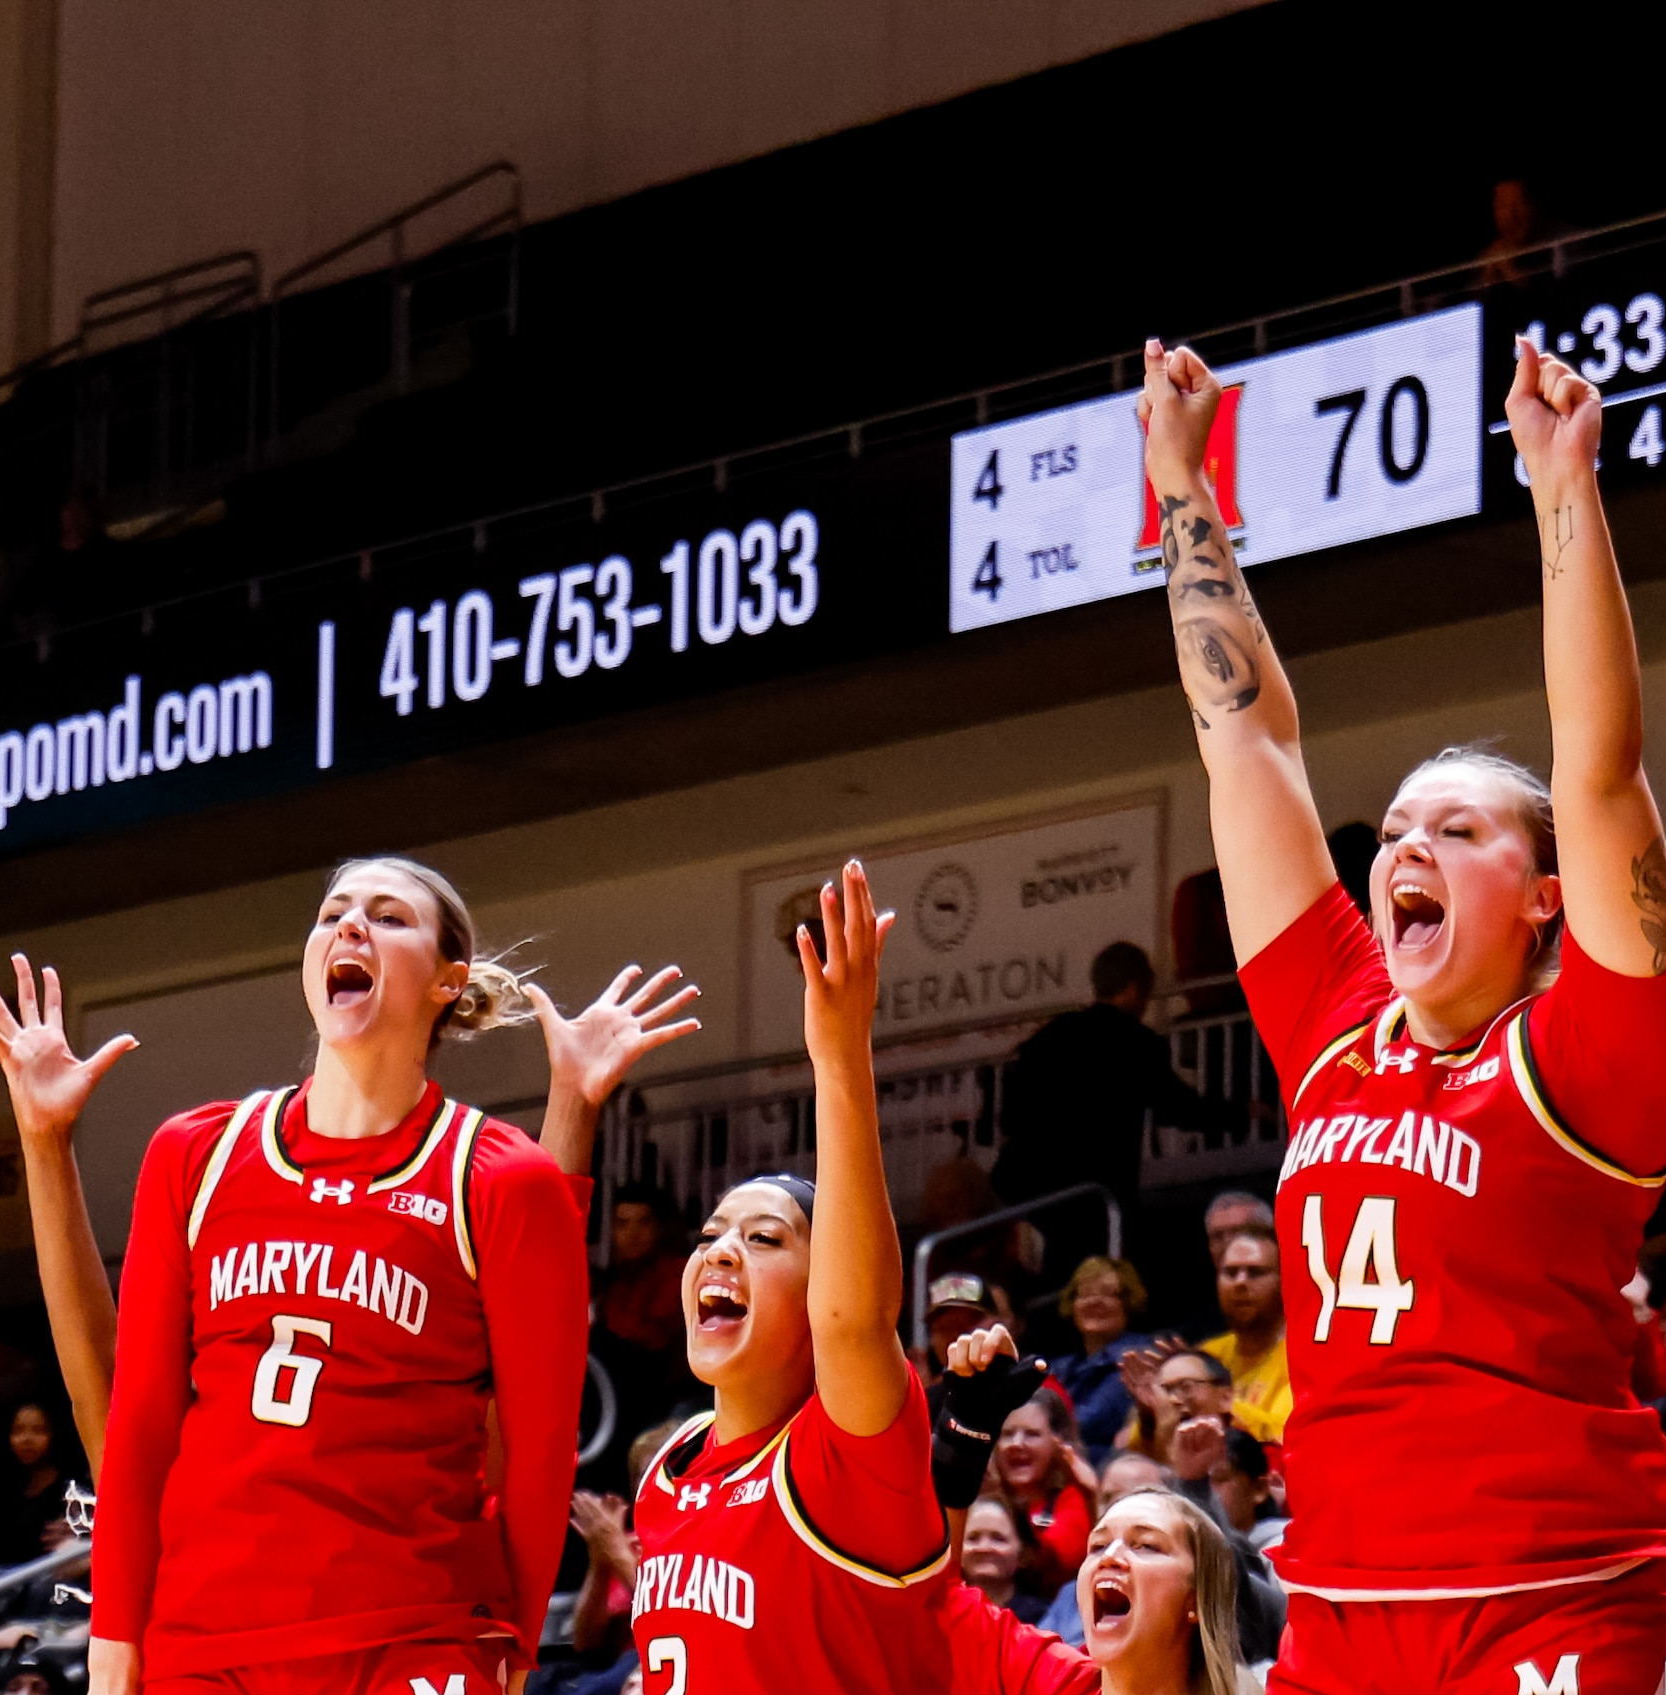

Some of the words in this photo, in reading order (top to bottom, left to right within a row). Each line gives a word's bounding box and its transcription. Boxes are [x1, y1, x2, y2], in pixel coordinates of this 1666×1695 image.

[973, 449, 1003, 510] 4
[1031, 445, 1079, 482] FLS
[1313, 374, 1430, 502] 70
[1628, 403, 1666, 468] 4
[379, 509, 820, 717] 410-753-1033
[971, 540, 1002, 601] 4
[1027, 543, 1079, 580] TOL
[210, 1240, 429, 1336] MARYLAND
[1301, 1194, 1415, 1345] 14
[250, 1313, 332, 1428] 6
